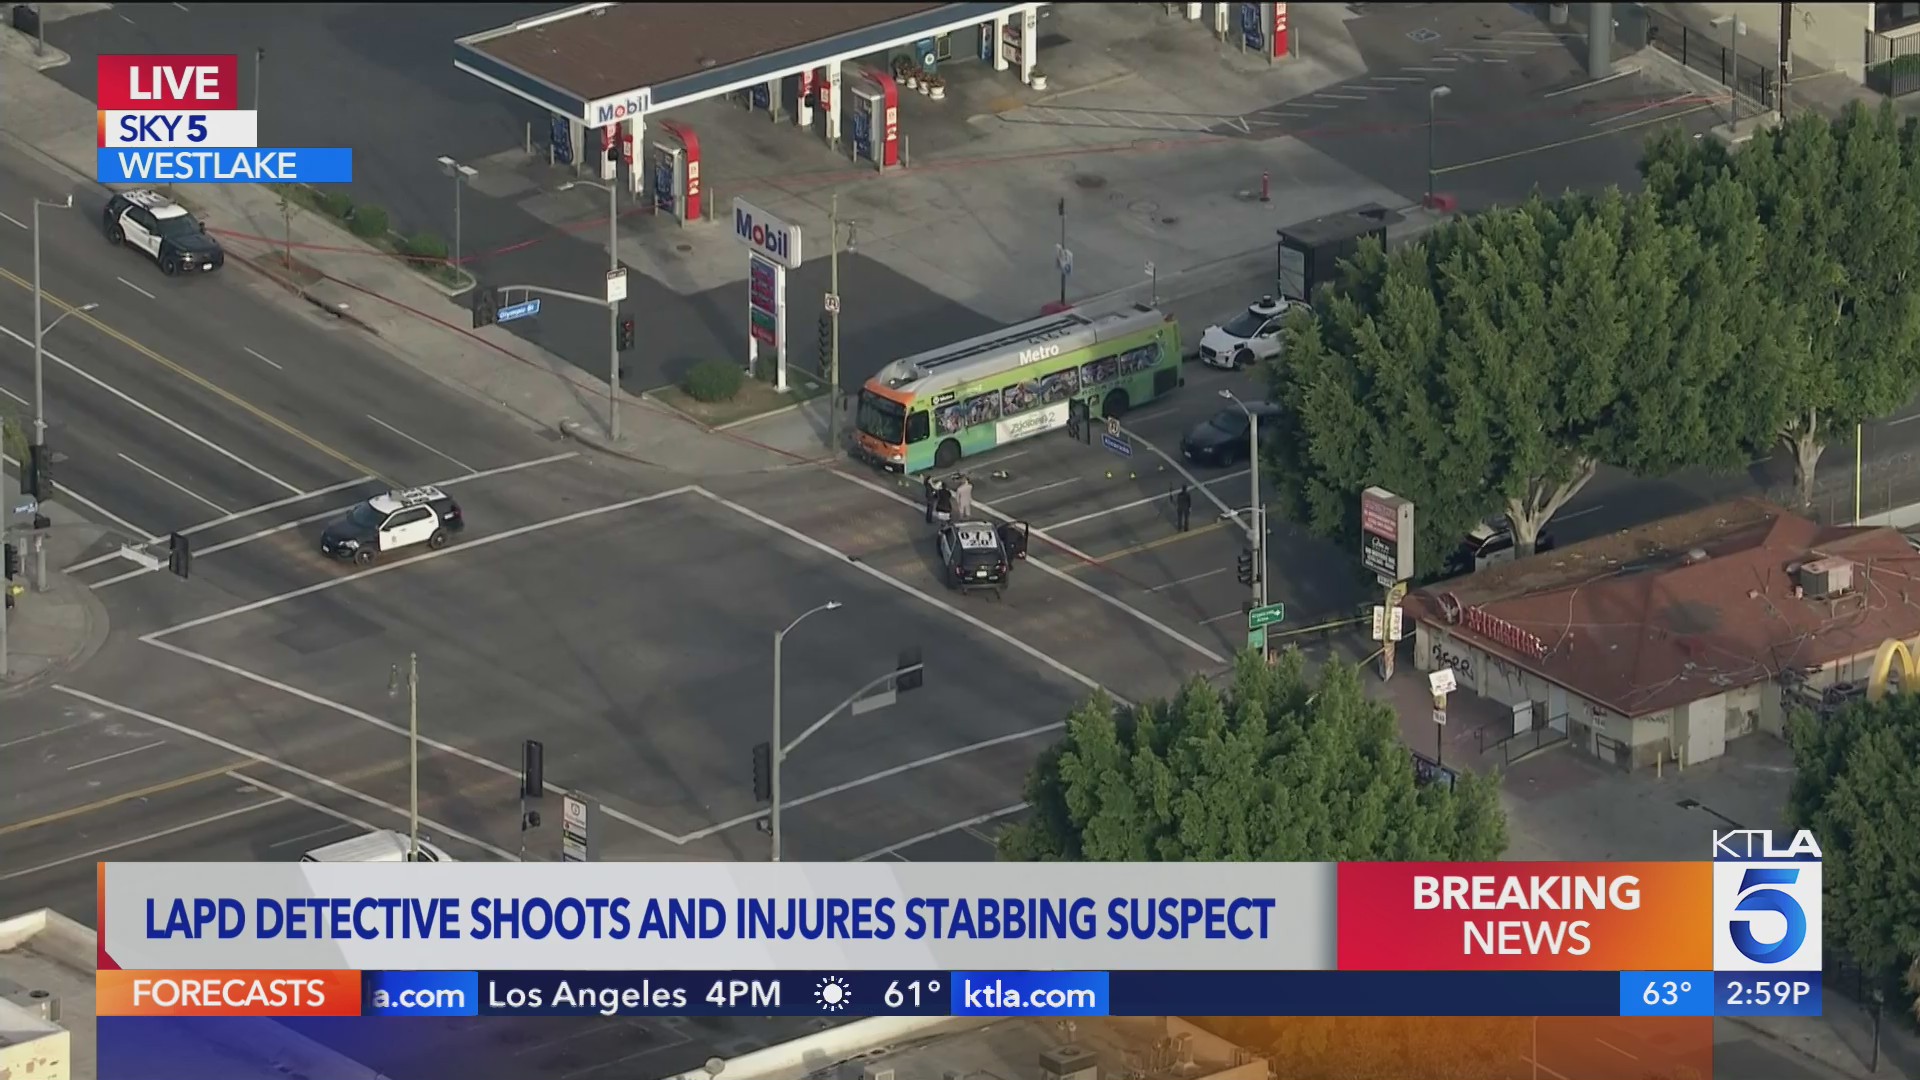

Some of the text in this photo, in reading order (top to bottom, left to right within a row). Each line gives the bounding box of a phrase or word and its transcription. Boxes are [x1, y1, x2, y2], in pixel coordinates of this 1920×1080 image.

[599, 95, 648, 121] Mobil
[736, 207, 788, 258] Mobil
[1019, 344, 1059, 366] Metro
